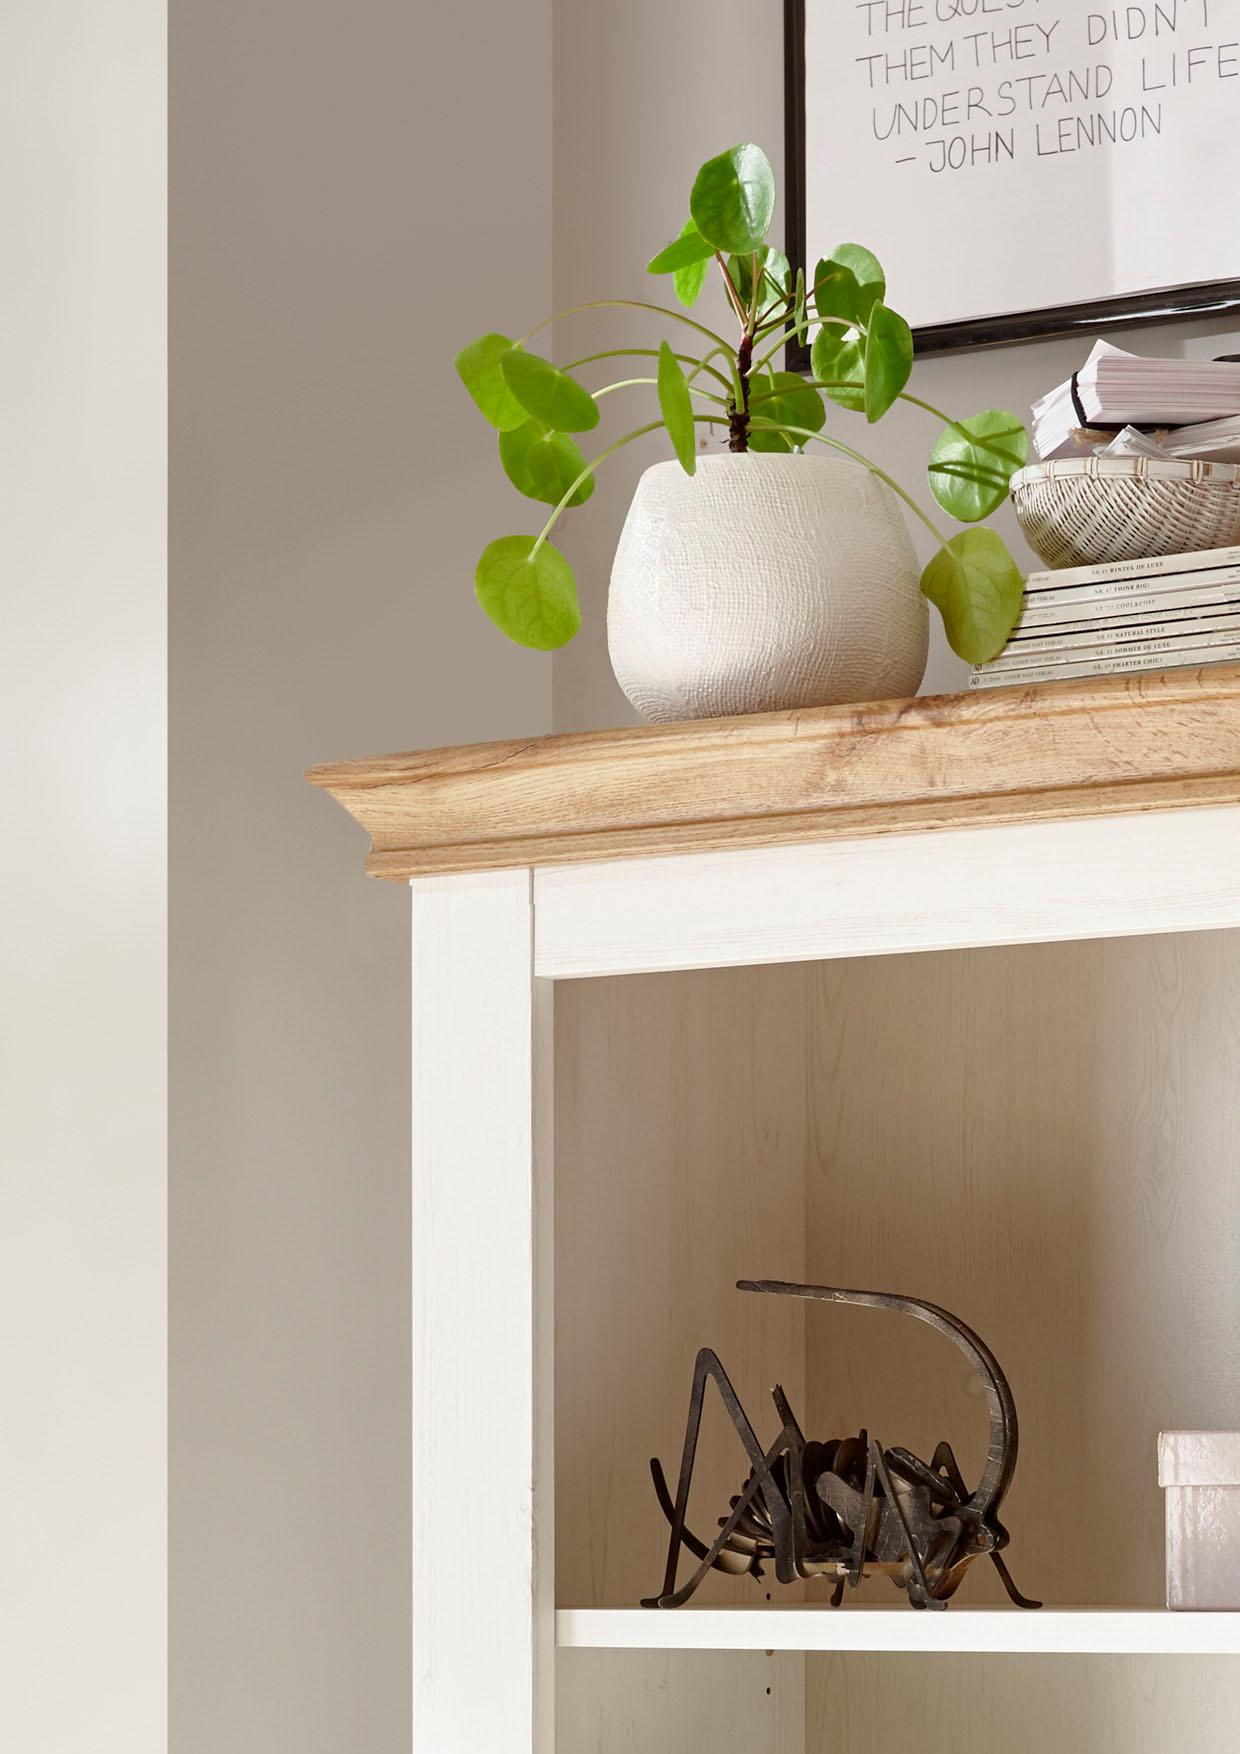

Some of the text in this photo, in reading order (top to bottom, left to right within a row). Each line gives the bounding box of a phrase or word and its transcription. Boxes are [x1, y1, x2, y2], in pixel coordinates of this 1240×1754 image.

[856, 0, 928, 36] THE
[856, 40, 954, 88] THEM
[963, 20, 1060, 67] THEY
[873, 65, 1112, 140] UNDERSTAND
[1036, 103, 1161, 155] LENNON
